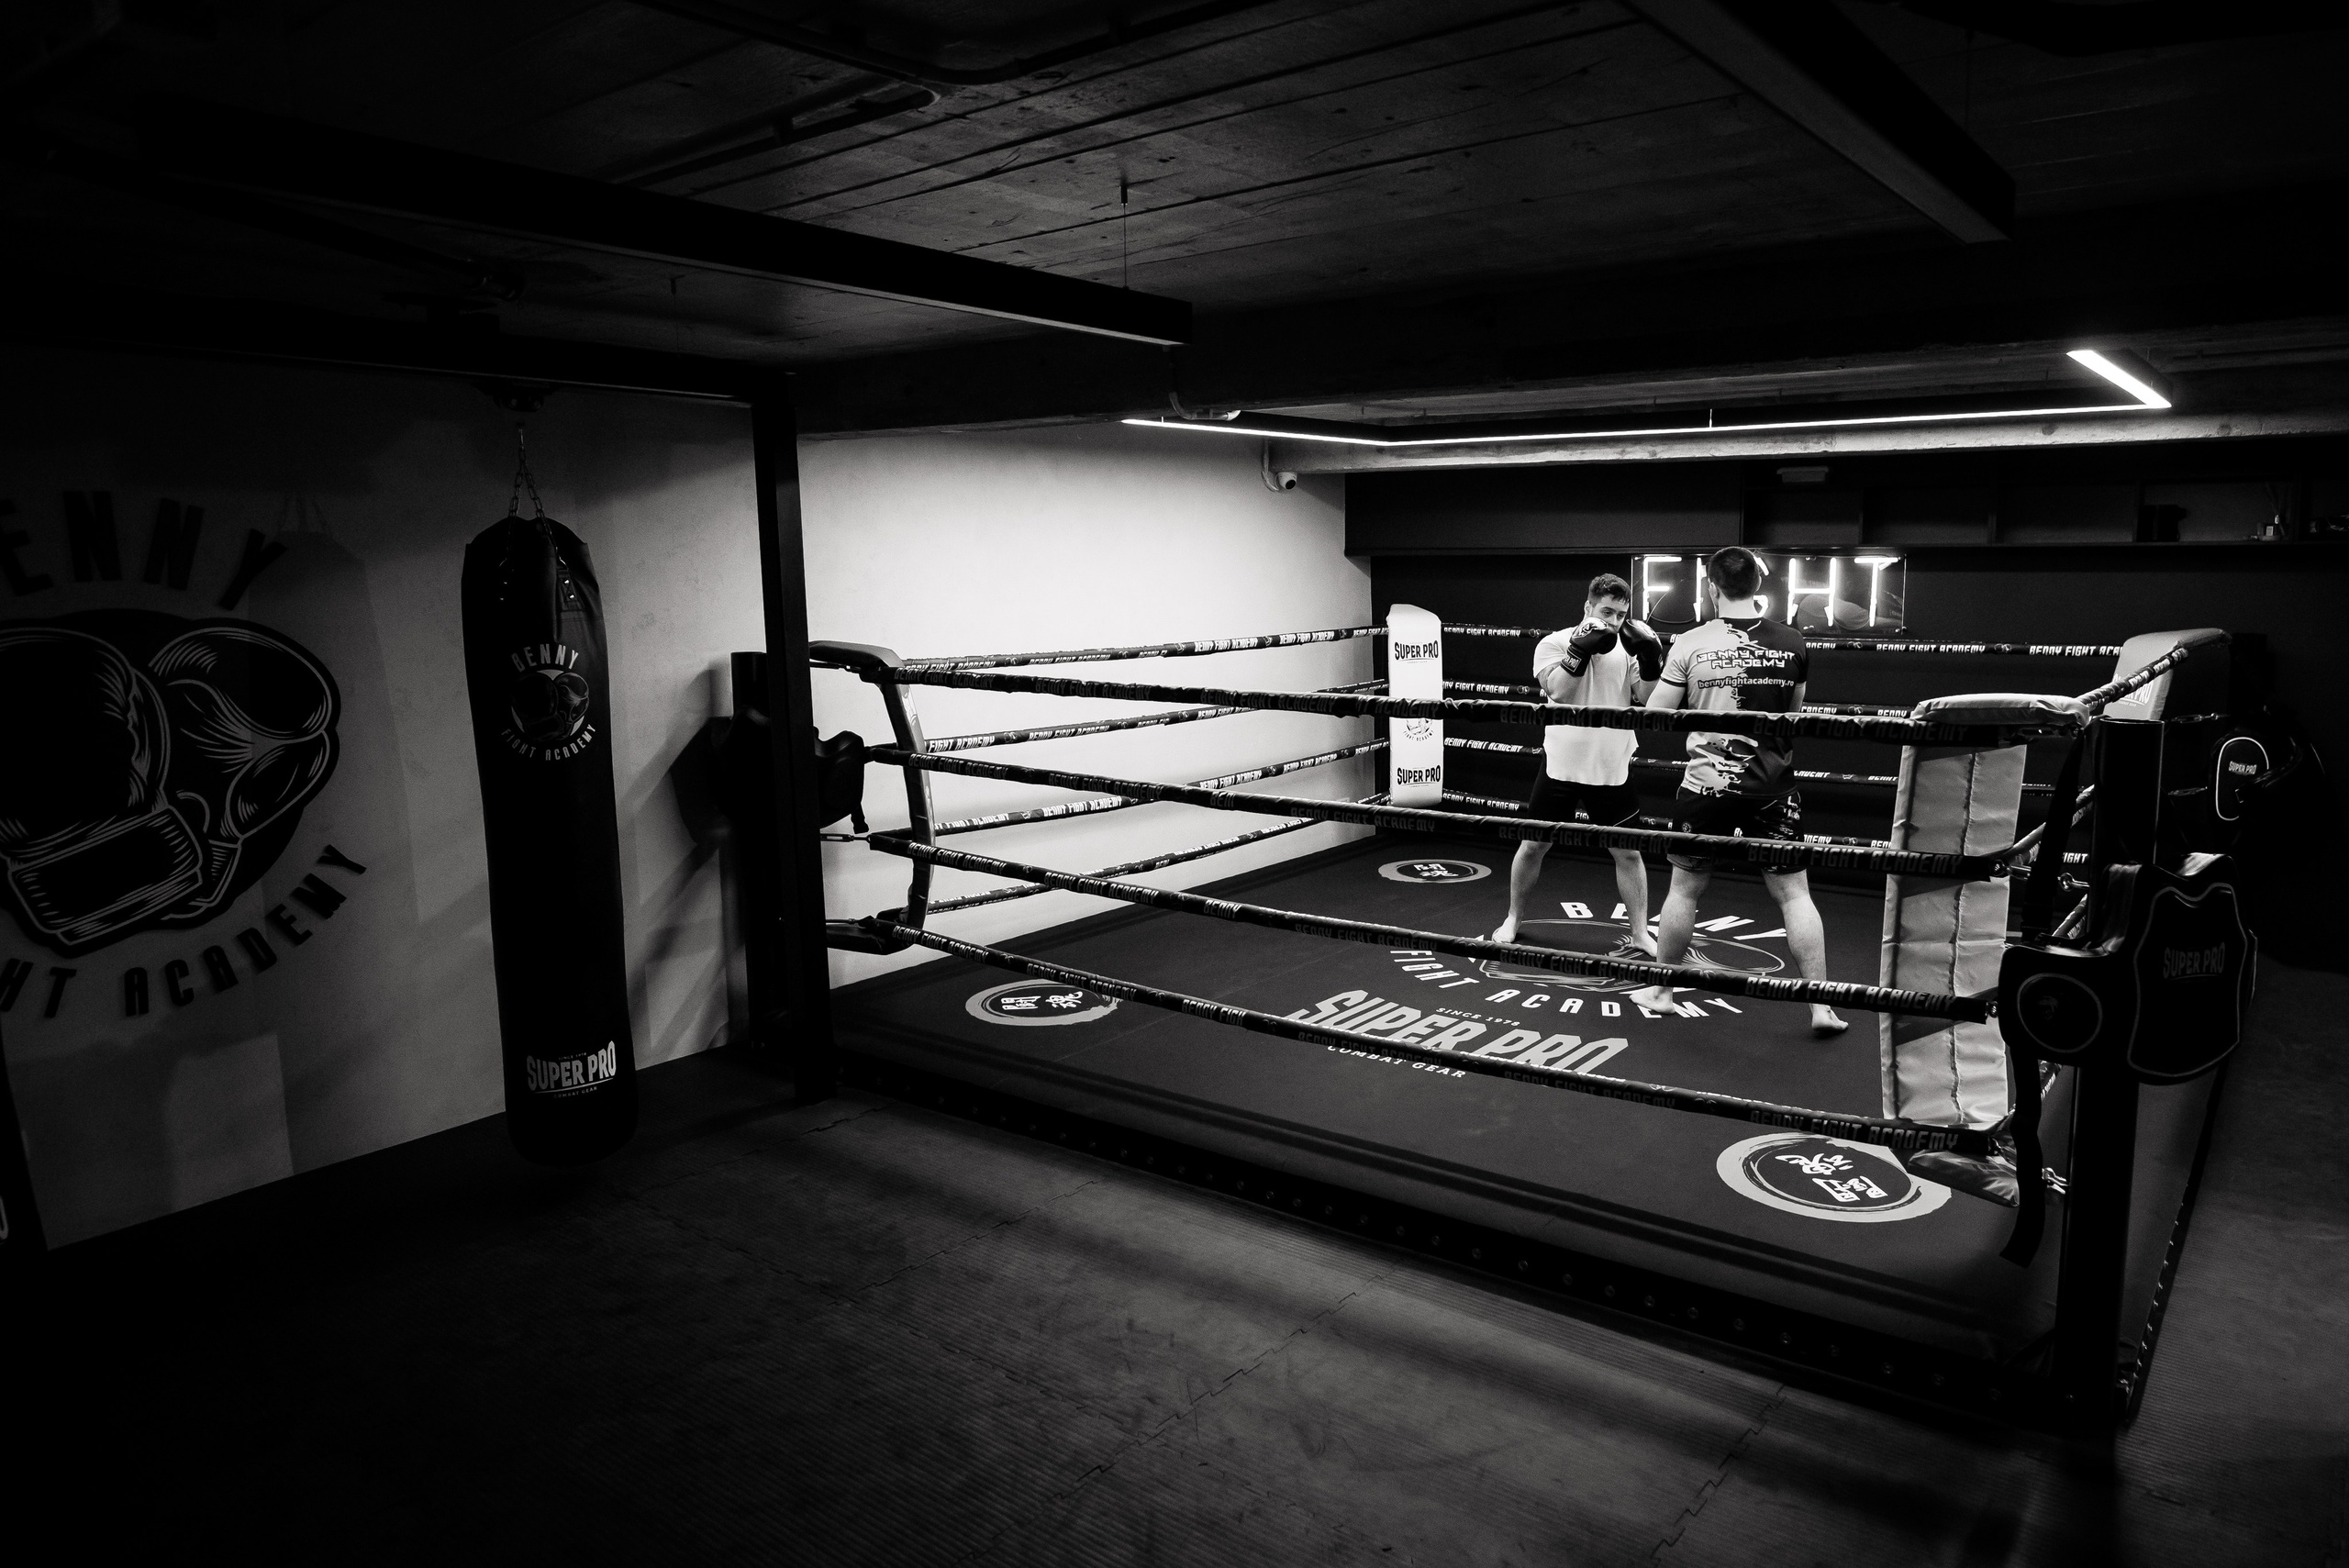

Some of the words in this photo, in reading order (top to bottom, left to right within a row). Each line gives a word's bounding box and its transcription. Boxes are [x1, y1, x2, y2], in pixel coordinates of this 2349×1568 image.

[0, 490, 287, 611] ENNY
[1443, 627, 1465, 635] BENNY
[1466, 627, 1486, 637] FIGHT
[1487, 628, 1520, 638] ACADEMY
[1805, 641, 1836, 650] ADEMY
[510, 643, 579, 673] BENNY
[1395, 641, 1421, 661] SUPER
[1423, 639, 1439, 659] PRO
[1754, 650, 1796, 661] FIGHT
[1876, 643, 1906, 652] BENNY
[1909, 643, 1937, 653] FIGHT
[1939, 644, 1986, 654] ACADEMY
[2029, 645, 2062, 656] BENNY
[2065, 645, 2097, 657] FIGHT
[894, 667, 922, 682] BENNY
[924, 669, 952, 684] FIGHT
[952, 671, 996, 688] ACADEMY
[1711, 658, 1786, 670] ACADEMY
[1454, 682, 1475, 693] FIGHT
[1476, 683, 1510, 695] ACADEMY
[1698, 676, 1795, 689] bennyfightacademy.ro
[1200, 688, 1239, 706] BENNY
[1240, 692, 1275, 708] FIGHT
[1278, 695, 1337, 712] ACADEMY
[1801, 706, 1837, 715] CADEMY
[1876, 708, 1908, 718] BENNY
[1499, 706, 1547, 726] BENNY
[1552, 708, 1597, 728] FIGHT
[1601, 710, 1677, 732] ACADEMY
[501, 728, 537, 758] FIGHT
[545, 724, 596, 761] ACADEMY
[927, 739, 954, 752] FIGHT
[954, 736, 996, 751] ACADEMY
[907, 753, 938, 769] BENNY
[938, 757, 965, 774] FIGHT
[965, 762, 1009, 780] ACADEMY
[1397, 767, 1423, 785] SUPER
[1425, 764, 1441, 783] PRO
[2228, 760, 2245, 773] SUPER
[2245, 763, 2257, 775] PRO
[1048, 773, 1080, 790] BENNY
[1082, 776, 1111, 794] FIGHT
[1113, 781, 1164, 801] ACADEMY
[1290, 806, 1330, 821] BENNY
[1333, 810, 1369, 825] FIGHT
[1375, 814, 1437, 832] ACADEMY
[1497, 825, 1545, 843] BENNY
[1549, 828, 1594, 847] FIGHT
[1598, 831, 1674, 854] ACADEMY
[907, 841, 936, 862] BENNY
[935, 848, 963, 868] FIGHT
[963, 854, 1007, 876] ACADEMY
[1747, 842, 1804, 864] BENNY
[1809, 846, 1865, 869] FIGHT
[1870, 849, 1964, 874] ACADEMY
[2063, 851, 2089, 864] IGHT
[1044, 871, 1076, 892] BENNY
[1077, 877, 1108, 897] FIGHT
[1108, 883, 1160, 906] ACADEMY
[1203, 898, 1241, 919] BENNY
[1560, 901, 1787, 940] BENY
[125, 844, 366, 1017] ACADEMY
[892, 924, 921, 943] BENNY
[920, 931, 948, 951] FIGHT
[947, 940, 990, 964] ACADEMY
[1295, 923, 1331, 938] BENNY
[1337, 929, 1373, 944] FIGHT
[1376, 932, 1439, 951] ACADEMY
[1390, 948, 1480, 989] FIGHT
[1499, 949, 1545, 969] BENNY
[1549, 955, 1594, 976] FIGHT
[1598, 961, 1674, 986] ACADEMY
[2163, 946, 2200, 980] SUPER
[2202, 940, 2226, 973] PRO
[1026, 962, 1057, 982] BENNY
[1058, 971, 1088, 990] FIGHT
[1089, 979, 1139, 1002] ACADEMY
[1744, 974, 1803, 1001] BENNY
[1806, 979, 1863, 1006] FIGHT
[1864, 984, 1956, 1013] ACADEMY
[1181, 998, 1218, 1020] BENNY
[1219, 1006, 1247, 1028] FIGH
[1434, 1006, 1481, 1021] SINCE
[1485, 1015, 1523, 1029] 1978
[1284, 989, 1488, 1051] SUPER
[1478, 1029, 1629, 1075] PRO
[1297, 1030, 1338, 1049] BENNY
[1341, 1038, 1379, 1056] FIGHT
[1381, 1045, 1443, 1067] ACADEMY
[526, 1054, 585, 1092] SUPER
[587, 1040, 617, 1083] PRO
[1411, 1060, 1467, 1079] GEAR
[1749, 1108, 1805, 1130] BENNY
[1809, 1118, 1862, 1141] FIGHT
[1867, 1125, 1960, 1151] ACADEMY
